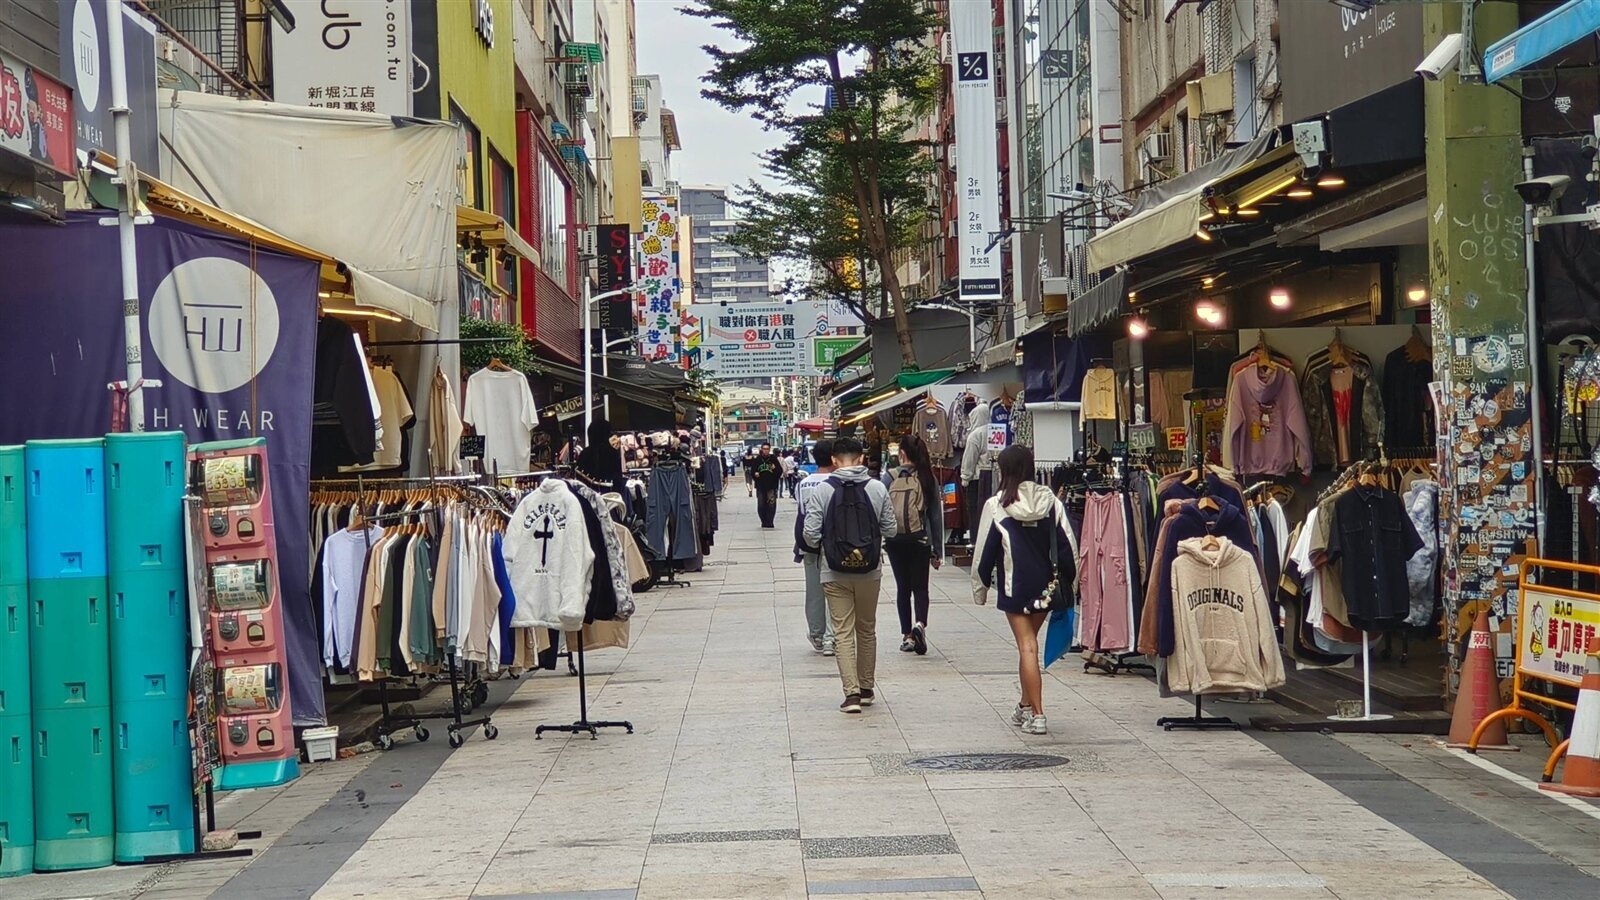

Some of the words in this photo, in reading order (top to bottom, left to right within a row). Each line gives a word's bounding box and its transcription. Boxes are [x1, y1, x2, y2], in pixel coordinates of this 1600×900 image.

[385, 0, 401, 81] .com.tw
[307, 85, 376, 99] 新堀江店
[76, 120, 104, 148] H.WEAR
[968, 177, 979, 187] 3F
[967, 189, 981, 197] 男裝
[969, 211, 980, 222] 2F
[968, 223, 982, 231] 女裝
[970, 245, 981, 255] 1F
[969, 257, 990, 265] 男女裝
[601, 301, 610, 328] SENSE
[758, 328, 795, 341] 職人風
[1470, 382, 1488, 394] 24K
[153, 407, 275, 431] H.WEAR
[991, 431, 1005, 445] 290
[1132, 430, 1154, 447] 500
[1459, 532, 1478, 545] 24K
[1186, 587, 1245, 613] ORIGINALS
[1554, 599, 1573, 616] 出入口
